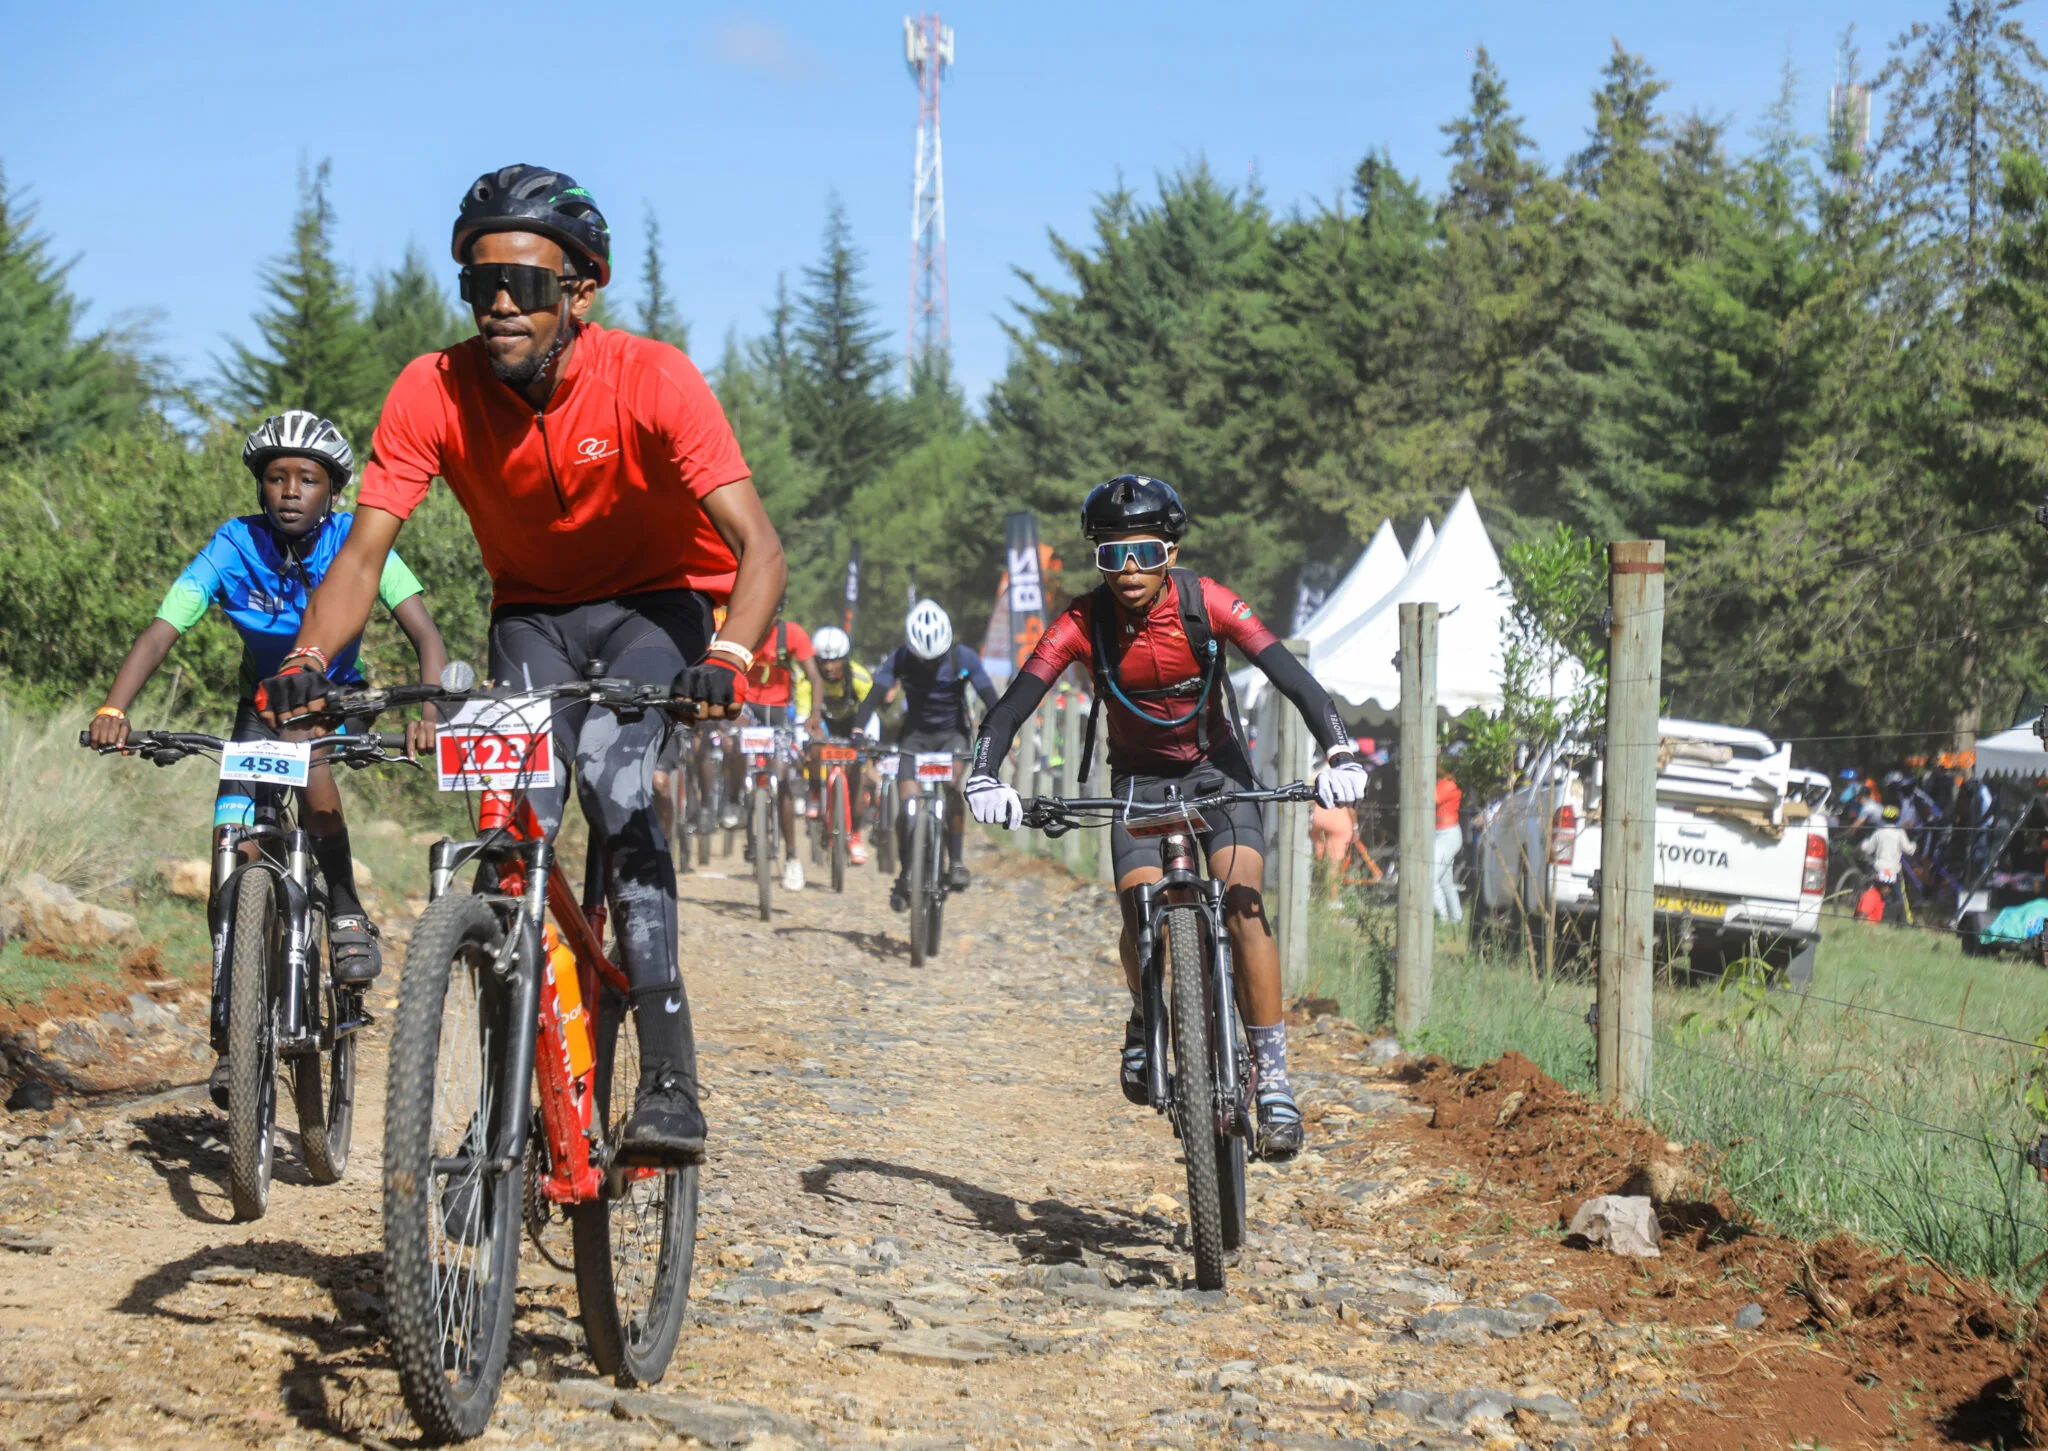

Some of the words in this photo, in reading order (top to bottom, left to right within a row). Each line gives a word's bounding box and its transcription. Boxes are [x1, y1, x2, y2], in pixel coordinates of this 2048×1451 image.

[240, 756, 290, 774] 458
[460, 737, 526, 771] 123
[1657, 844, 1729, 868] TOYOTA
